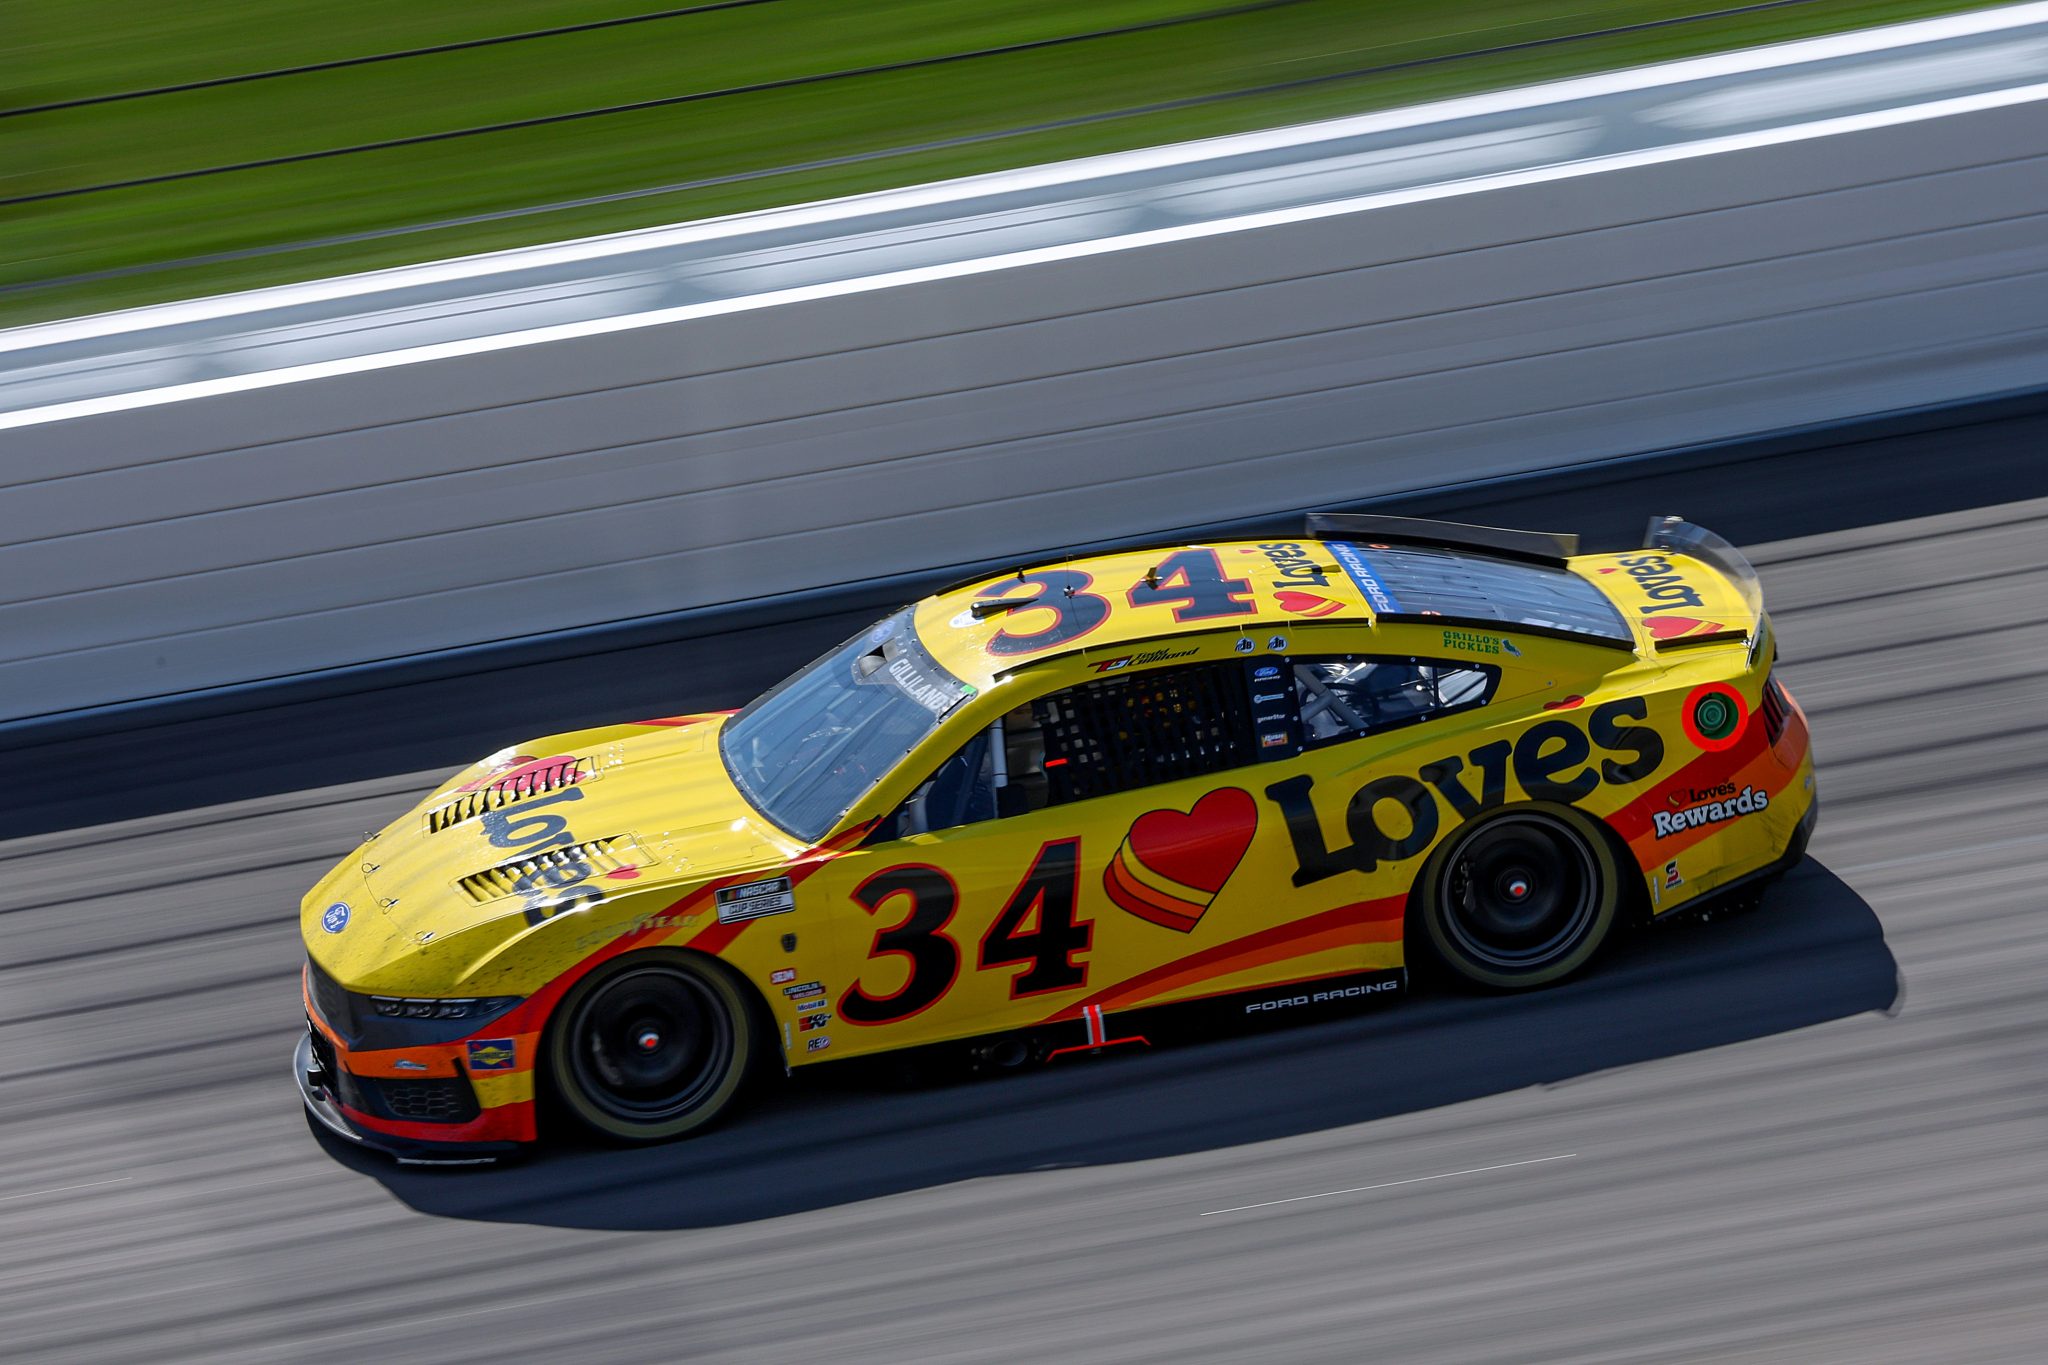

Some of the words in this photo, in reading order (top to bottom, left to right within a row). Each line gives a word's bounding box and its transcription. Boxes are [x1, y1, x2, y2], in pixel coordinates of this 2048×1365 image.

[1331, 544, 1372, 578] RACING
[975, 548, 1259, 656] 34
[1363, 578, 1395, 613] FORD
[1443, 631, 1499, 645] GRILLO'S
[1443, 639, 1499, 654] PICKLES
[889, 658, 952, 711] GILLILAND
[1653, 786, 1769, 838] Rewards
[729, 902, 748, 914] CUP
[749, 897, 783, 911] SERIES
[738, 882, 781, 900] NASCAR
[839, 836, 1095, 1026] 34
[1246, 995, 1308, 1014] FORD
[1313, 980, 1398, 1002] RACING
